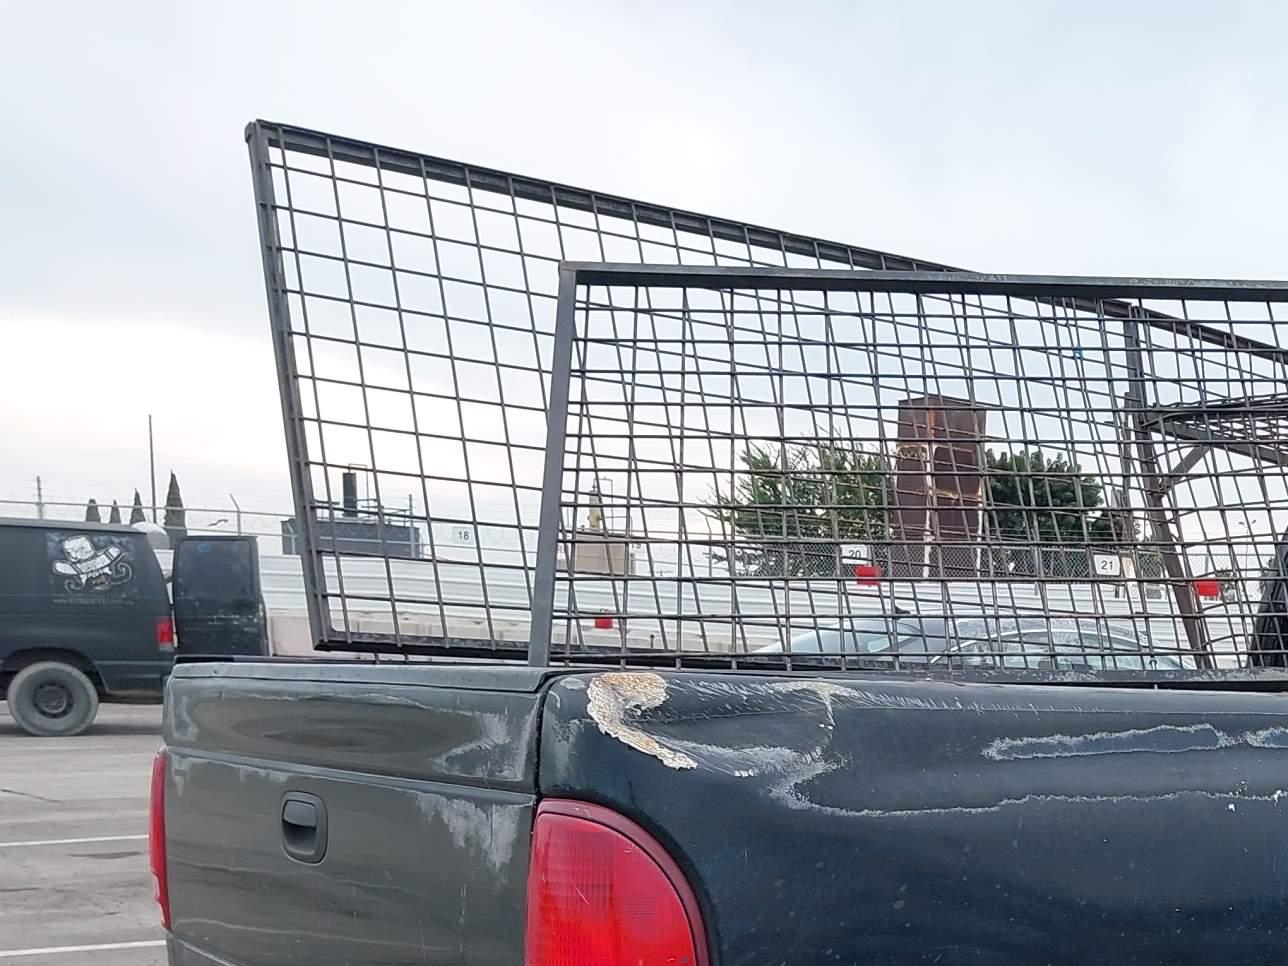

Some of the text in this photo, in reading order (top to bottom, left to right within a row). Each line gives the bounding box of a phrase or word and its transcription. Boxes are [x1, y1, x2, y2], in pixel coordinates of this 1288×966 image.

[458, 531, 470, 540] 18
[848, 549, 862, 559] 20
[1101, 560, 1113, 570] 21
